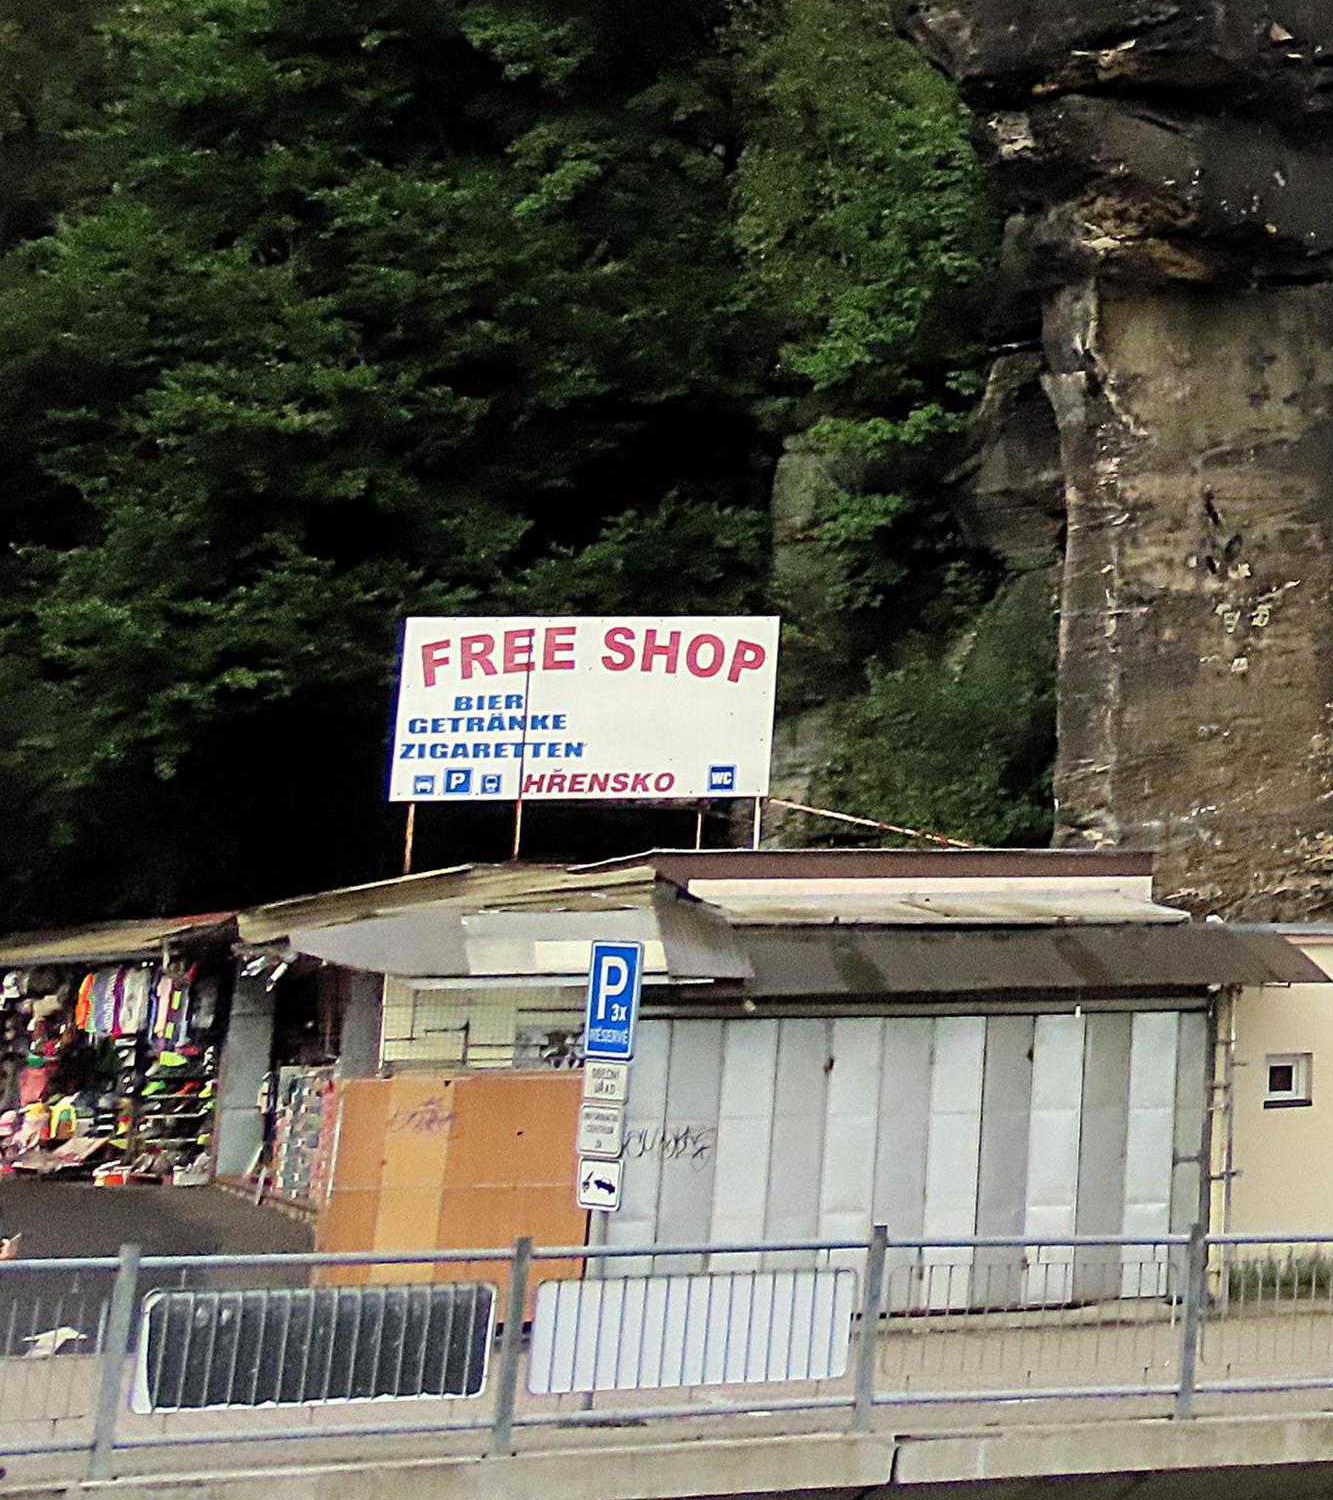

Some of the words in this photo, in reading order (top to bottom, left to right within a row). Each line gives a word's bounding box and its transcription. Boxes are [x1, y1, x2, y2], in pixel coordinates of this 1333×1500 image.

[420, 626, 577, 688] FREE
[601, 626, 767, 684] SHOP
[453, 694, 524, 712] BIER
[408, 713, 567, 734] GETRÄNKE
[400, 742, 586, 760] ZIGARETTEN
[450, 772, 466, 790] P
[521, 768, 676, 794] HŘENSKO
[710, 771, 733, 786] WC
[597, 956, 629, 1020] P
